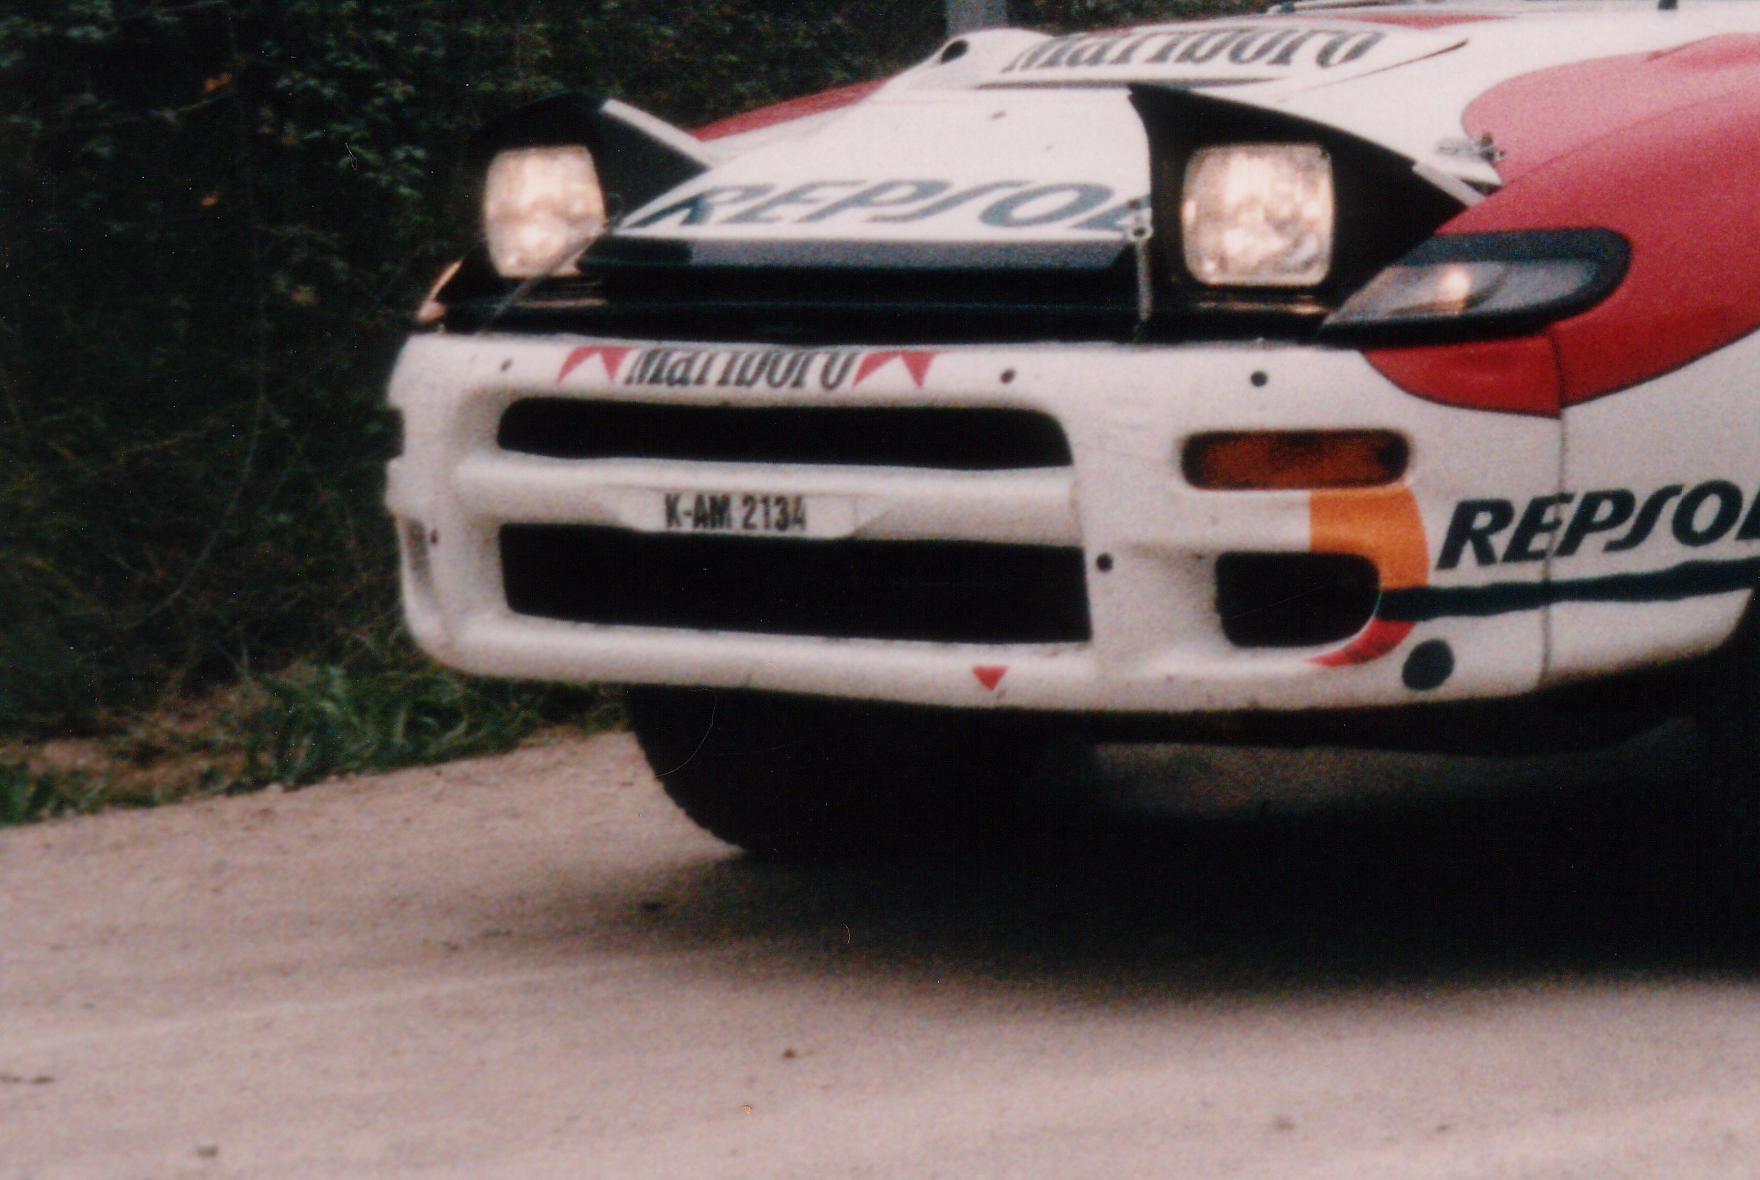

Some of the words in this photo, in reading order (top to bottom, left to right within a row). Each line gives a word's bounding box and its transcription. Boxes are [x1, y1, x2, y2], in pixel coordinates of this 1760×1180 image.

[618, 179, 1150, 232] REPSOL
[665, 493, 732, 530] K-AM
[742, 494, 807, 532] 2134
